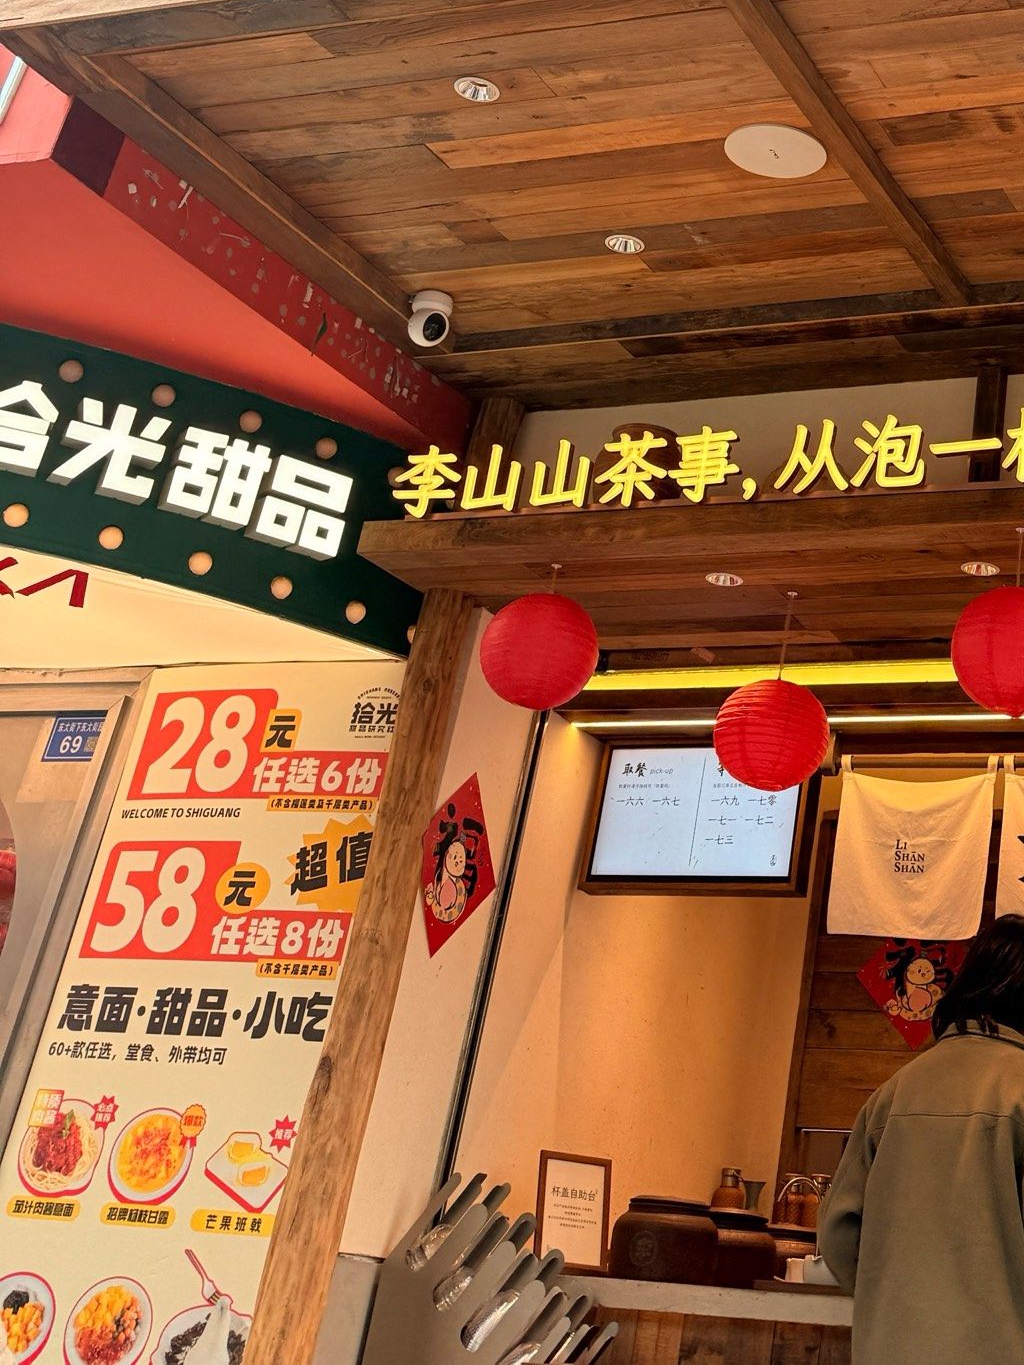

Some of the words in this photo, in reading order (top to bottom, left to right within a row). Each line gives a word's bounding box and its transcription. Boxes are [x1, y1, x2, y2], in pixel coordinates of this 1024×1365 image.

[351, 702, 399, 725] 拾光
[60, 735, 83, 754] 69
[141, 694, 257, 795] 28
[264, 715, 296, 749] 元
[251, 756, 383, 795] 任选6份
[622, 762, 648, 778] 取餐
[652, 796, 681, 807] 一六七
[711, 795, 740, 806] 一六九
[747, 794, 777, 806] 一七零
[121, 808, 169, 819] WELCOME
[170, 808, 184, 819] TO
[185, 807, 242, 819] SHIGUANG
[708, 815, 737, 825] 一七一
[744, 815, 774, 825] 一七二
[705, 835, 734, 845] 一七三
[290, 831, 374, 896] 超值
[89, 846, 207, 954] 58
[223, 871, 256, 907] 元
[209, 916, 345, 959] 任选8份
[259, 962, 333, 977] (不含千层类产品)
[56, 983, 334, 1042] 意面·甜品·小吃
[48, 1041, 228, 1066] 60+款任选，堂食、外带均可
[552, 1185, 597, 1202] 杯盖自助台
[205, 1214, 263, 1234] 芒果班戟
